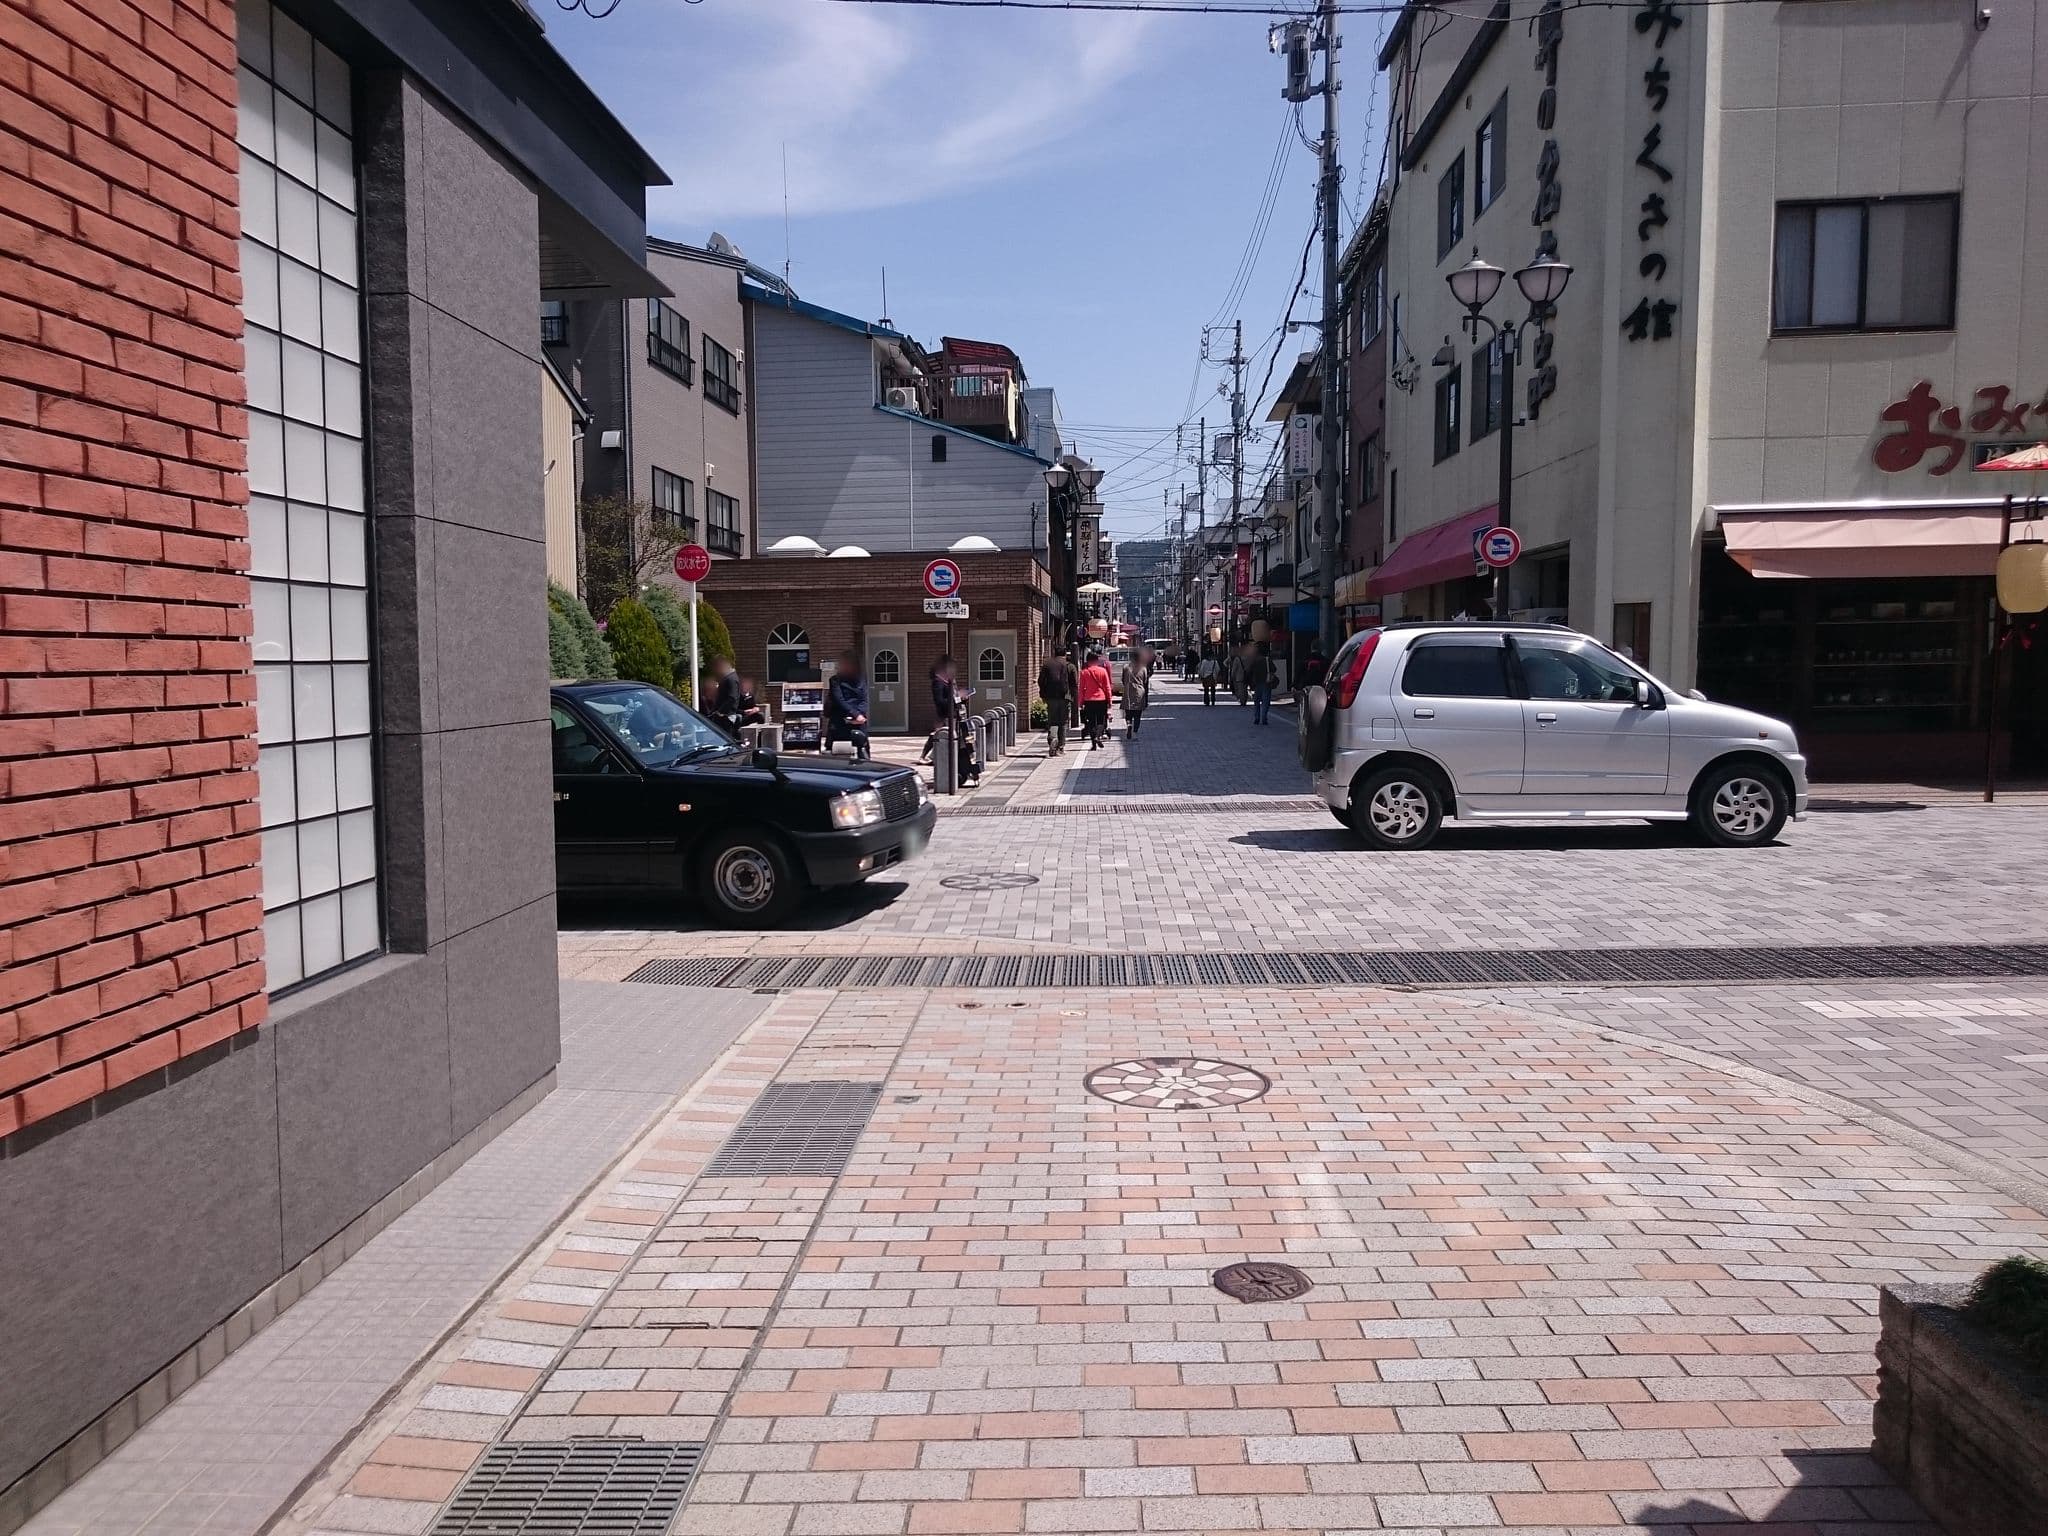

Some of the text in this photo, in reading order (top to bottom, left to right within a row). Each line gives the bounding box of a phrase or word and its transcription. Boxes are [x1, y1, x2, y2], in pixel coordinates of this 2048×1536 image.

[676, 555, 707, 570] 防火水そう
